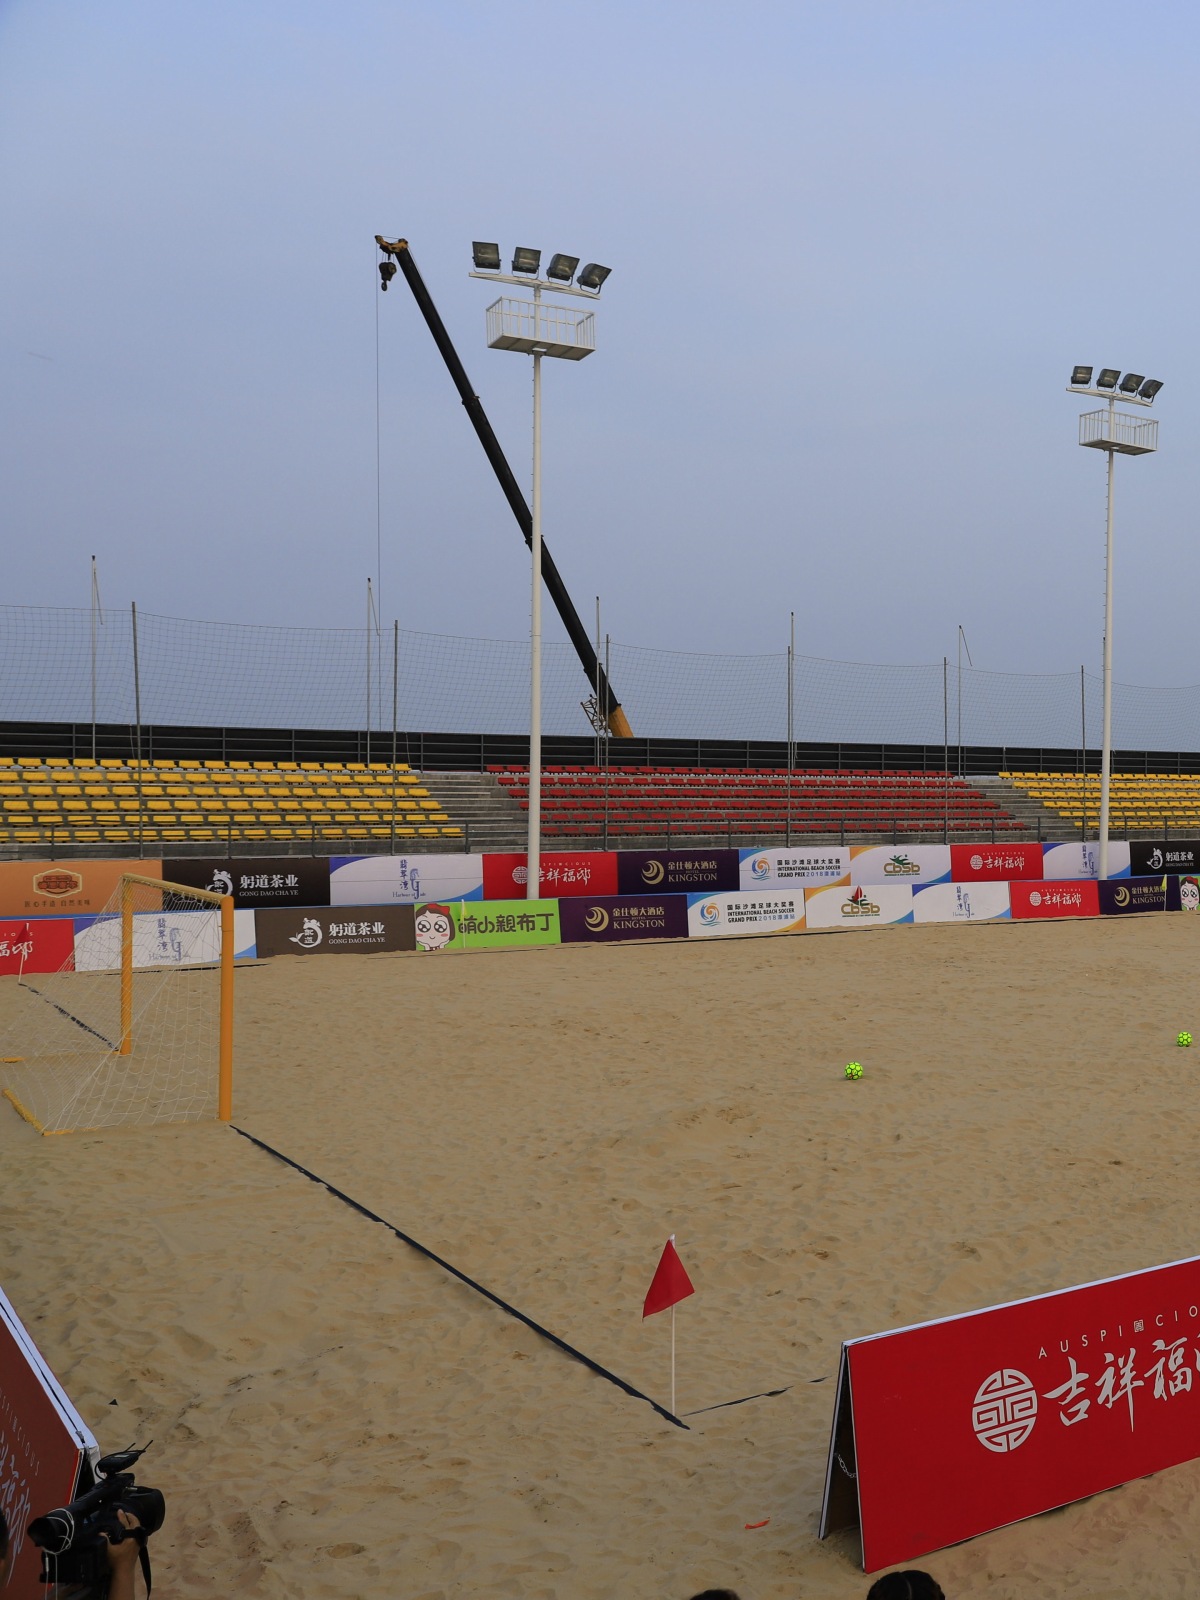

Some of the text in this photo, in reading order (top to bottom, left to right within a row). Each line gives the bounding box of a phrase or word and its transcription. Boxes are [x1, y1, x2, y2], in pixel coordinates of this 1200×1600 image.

[668, 861, 718, 870] 金仕顿大酒店
[984, 856, 1025, 872] 吉祥福邸
[240, 874, 299, 889] 躬道茶业
[399, 859, 408, 890] 翡翠湾
[668, 873, 718, 882] KINGSTON
[1043, 892, 1082, 908] 吉祥福邸
[612, 906, 665, 917] 金仕顿大酒店
[328, 922, 386, 937] 躬道茶业
[458, 912, 554, 935] 萌小親布丁
[613, 919, 665, 929] KINGSTON
